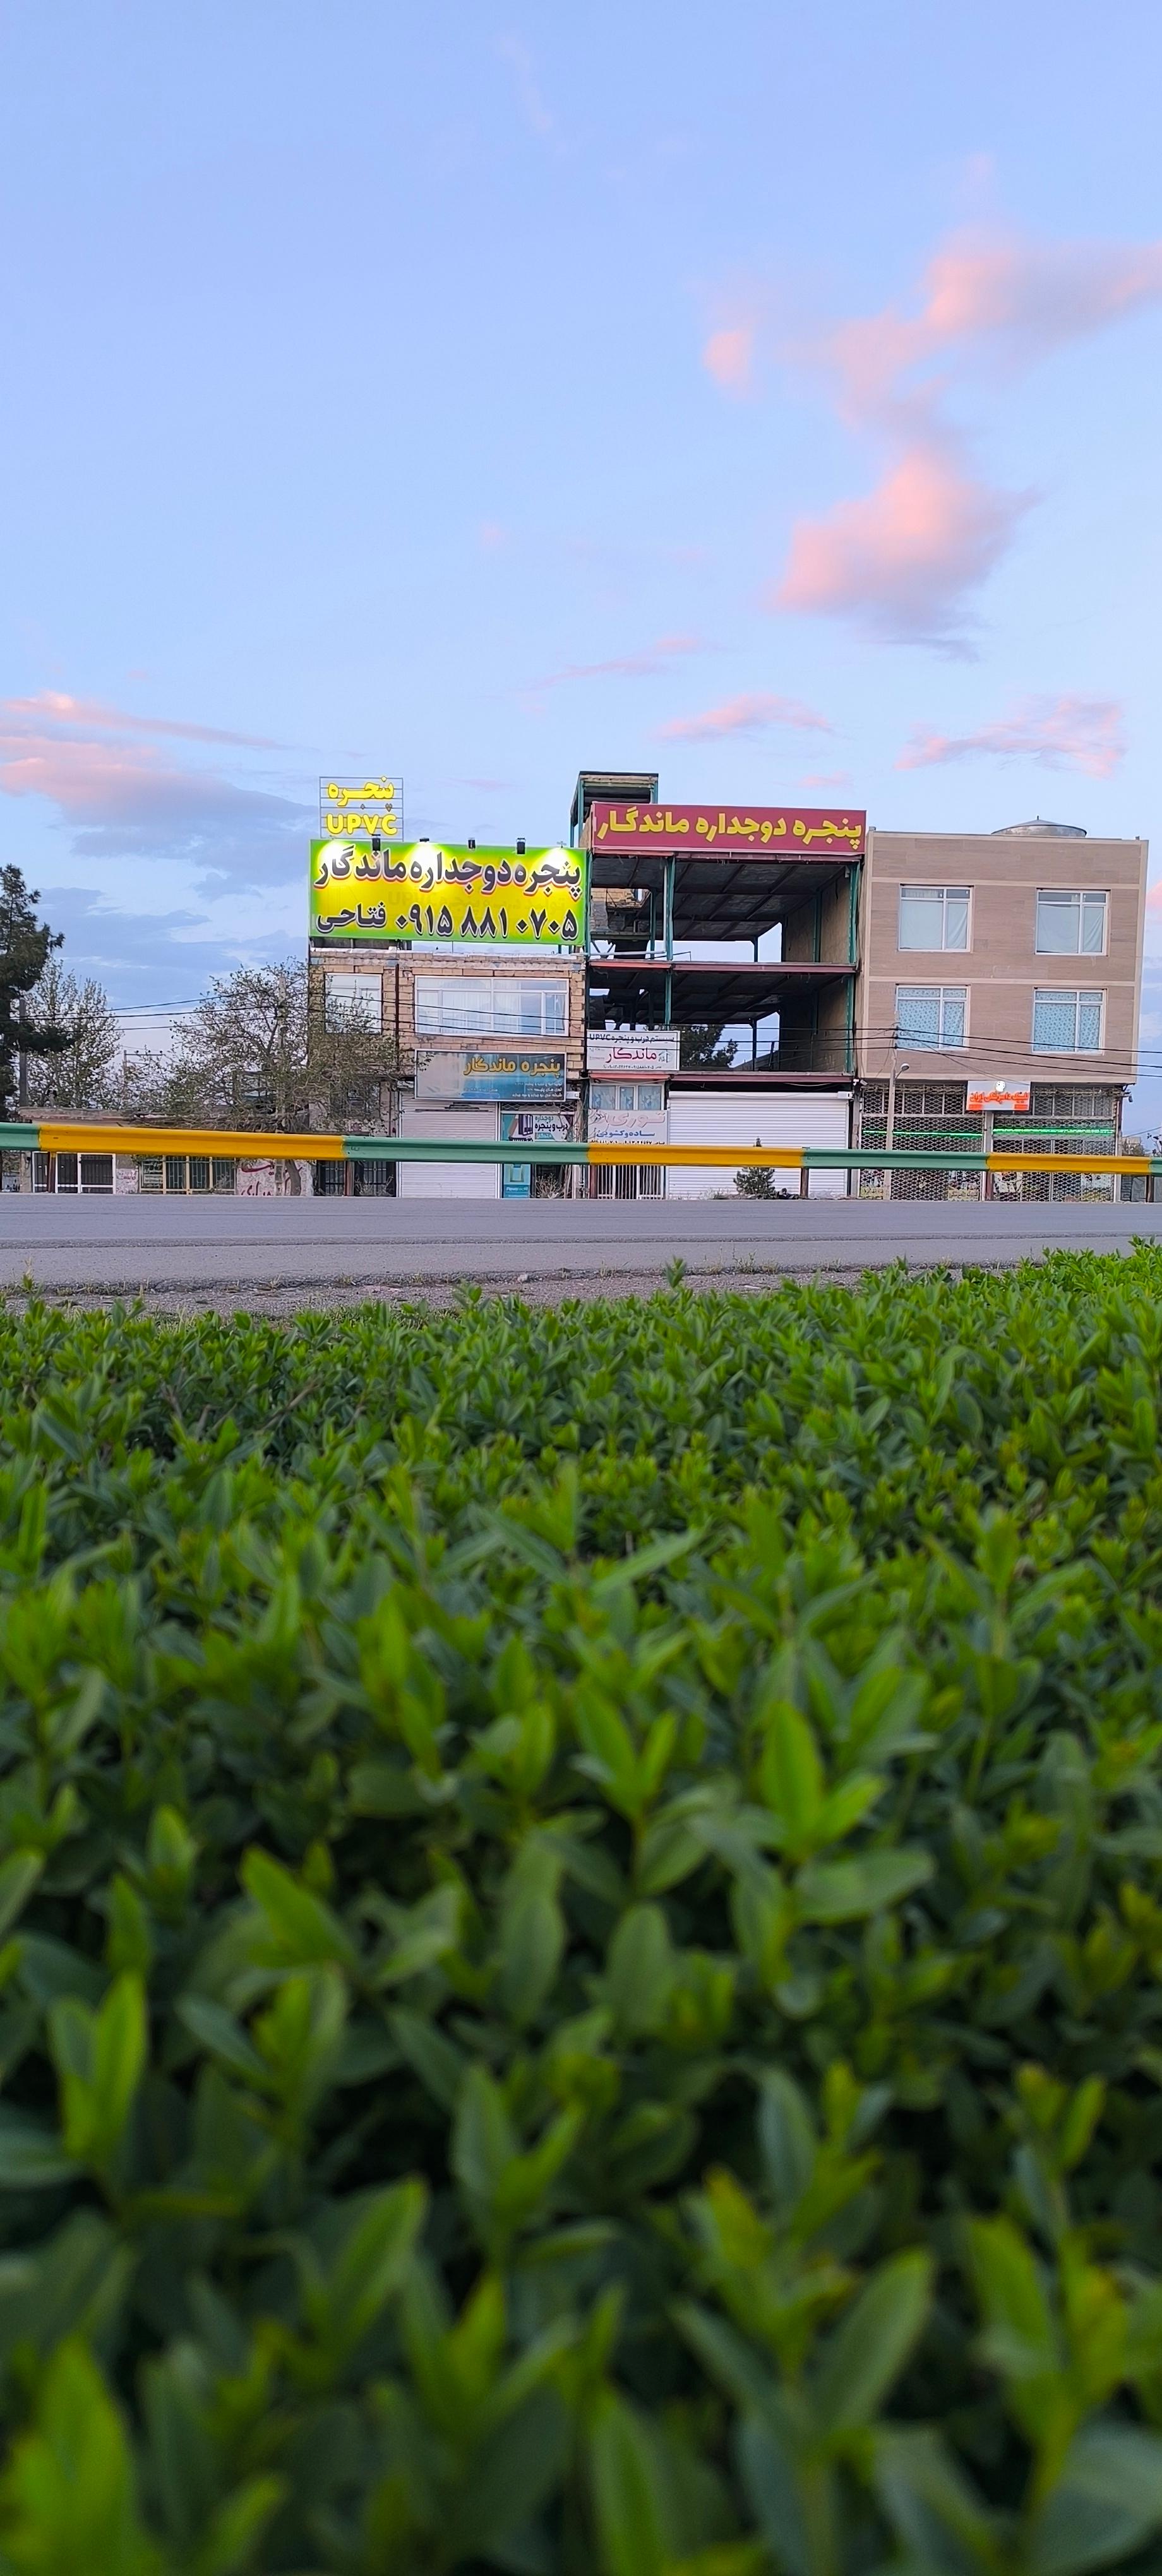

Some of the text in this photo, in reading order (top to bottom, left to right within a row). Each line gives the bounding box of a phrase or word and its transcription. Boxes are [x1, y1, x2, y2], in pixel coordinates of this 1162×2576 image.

[327, 776, 395, 812] پنجره
[327, 813, 397, 835] UPVC
[597, 806, 690, 840] ماندگار
[793, 817, 862, 850] پنجره
[314, 844, 407, 887] ماندگار
[513, 860, 582, 900] پنجره
[317, 902, 387, 934] فتاحی
[395, 903, 454, 936] ۰۹۱۵
[460, 907, 508, 938] ۸۸۱
[516, 908, 579, 940] ۰۷۰۵
[463, 1055, 561, 1079] پنجره ماندگار
[534, 1121, 552, 1131] پنجره
